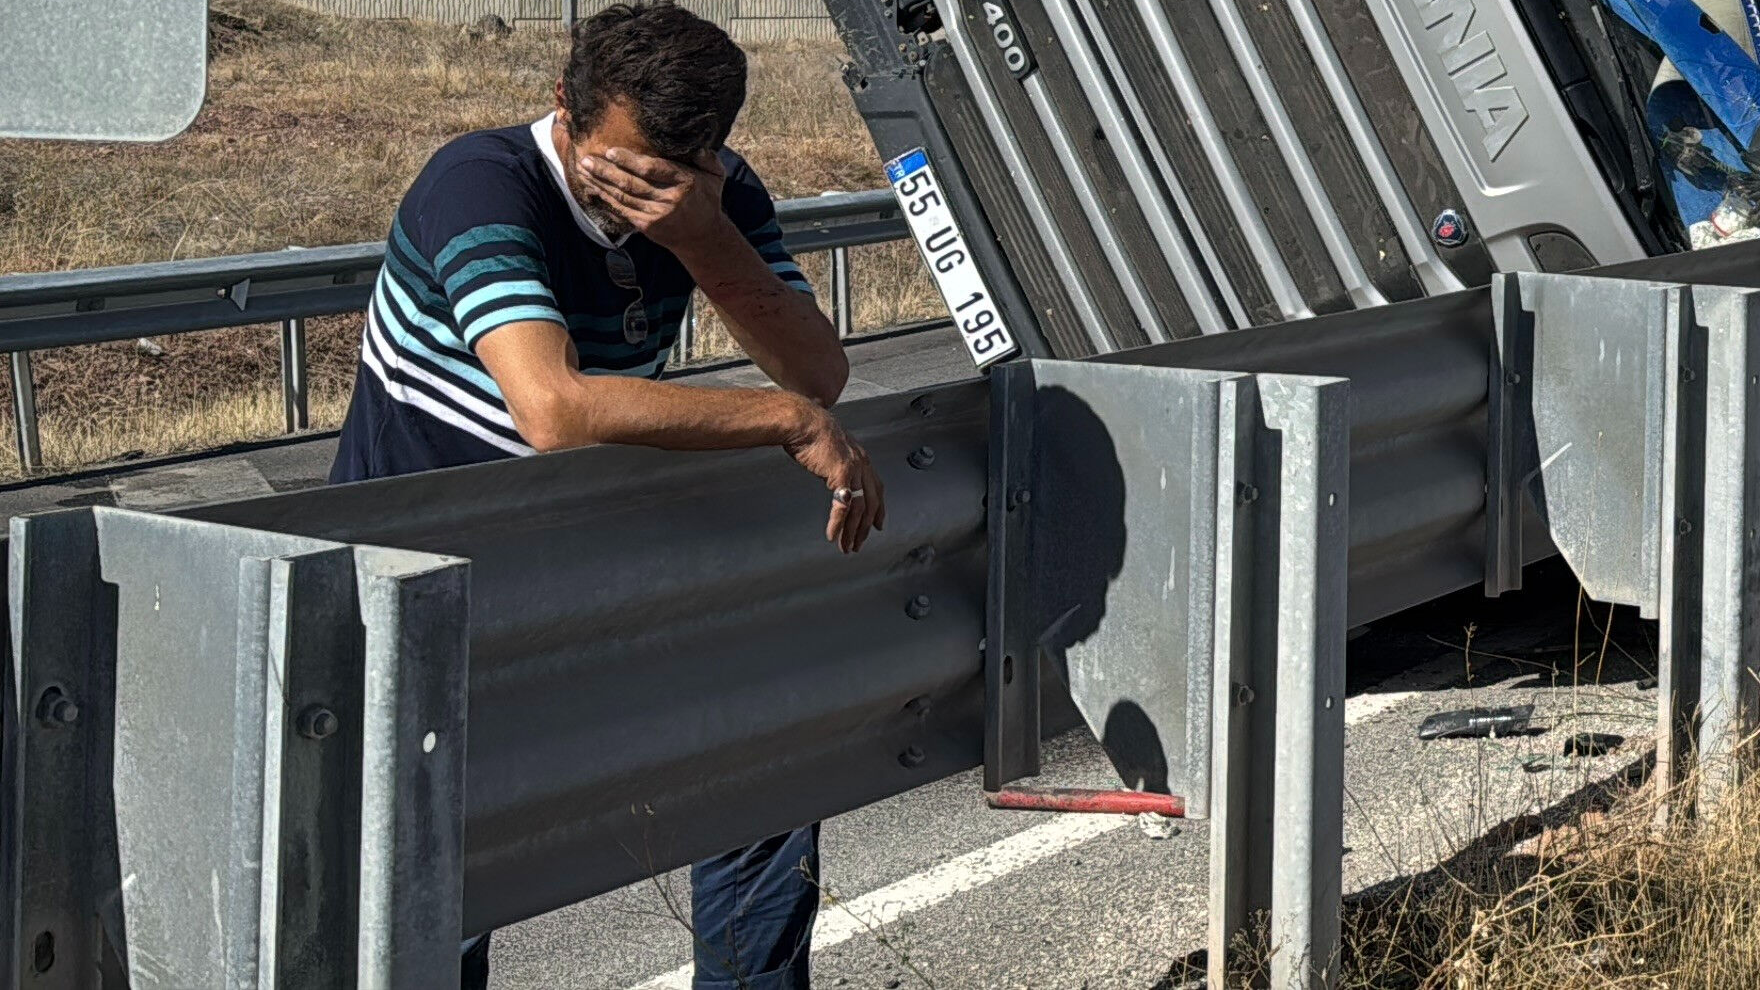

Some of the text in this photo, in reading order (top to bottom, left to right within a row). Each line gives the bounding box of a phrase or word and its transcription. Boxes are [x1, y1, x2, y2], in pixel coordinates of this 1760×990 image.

[982, 1, 1025, 72] 400
[900, 171, 1007, 355] 55 UG 195
